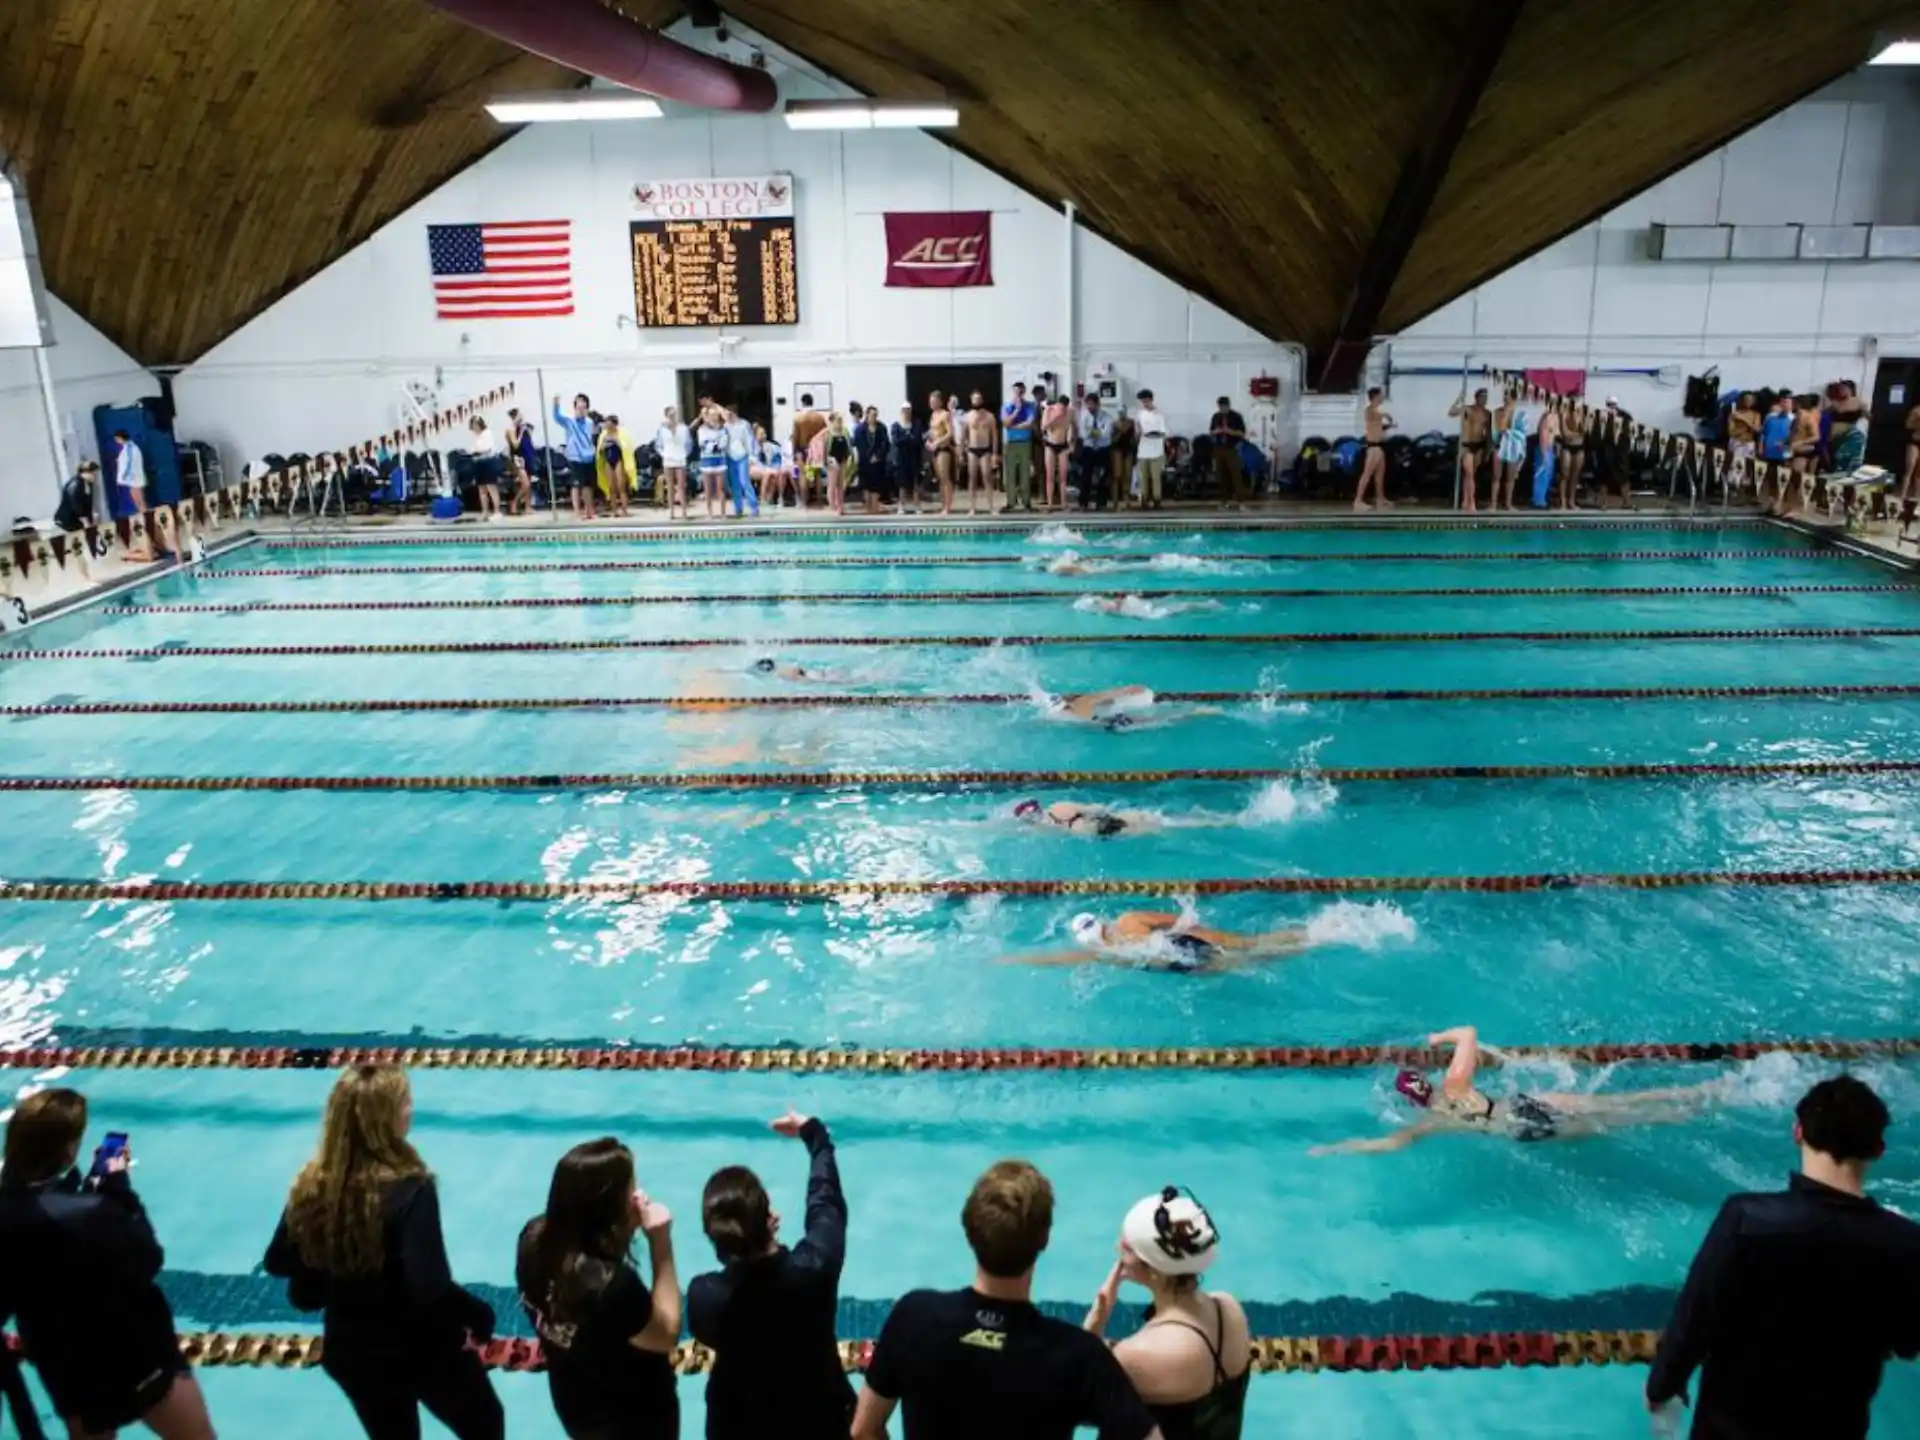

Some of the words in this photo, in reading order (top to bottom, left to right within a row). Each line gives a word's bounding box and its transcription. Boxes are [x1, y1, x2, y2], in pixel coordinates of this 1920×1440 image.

[659, 181, 759, 200] BOSTON
[652, 199, 770, 217] COLLEGE
[900, 233, 984, 262] ACC
[13, 597, 28, 625] 3
[959, 1328, 1008, 1350] ACC
